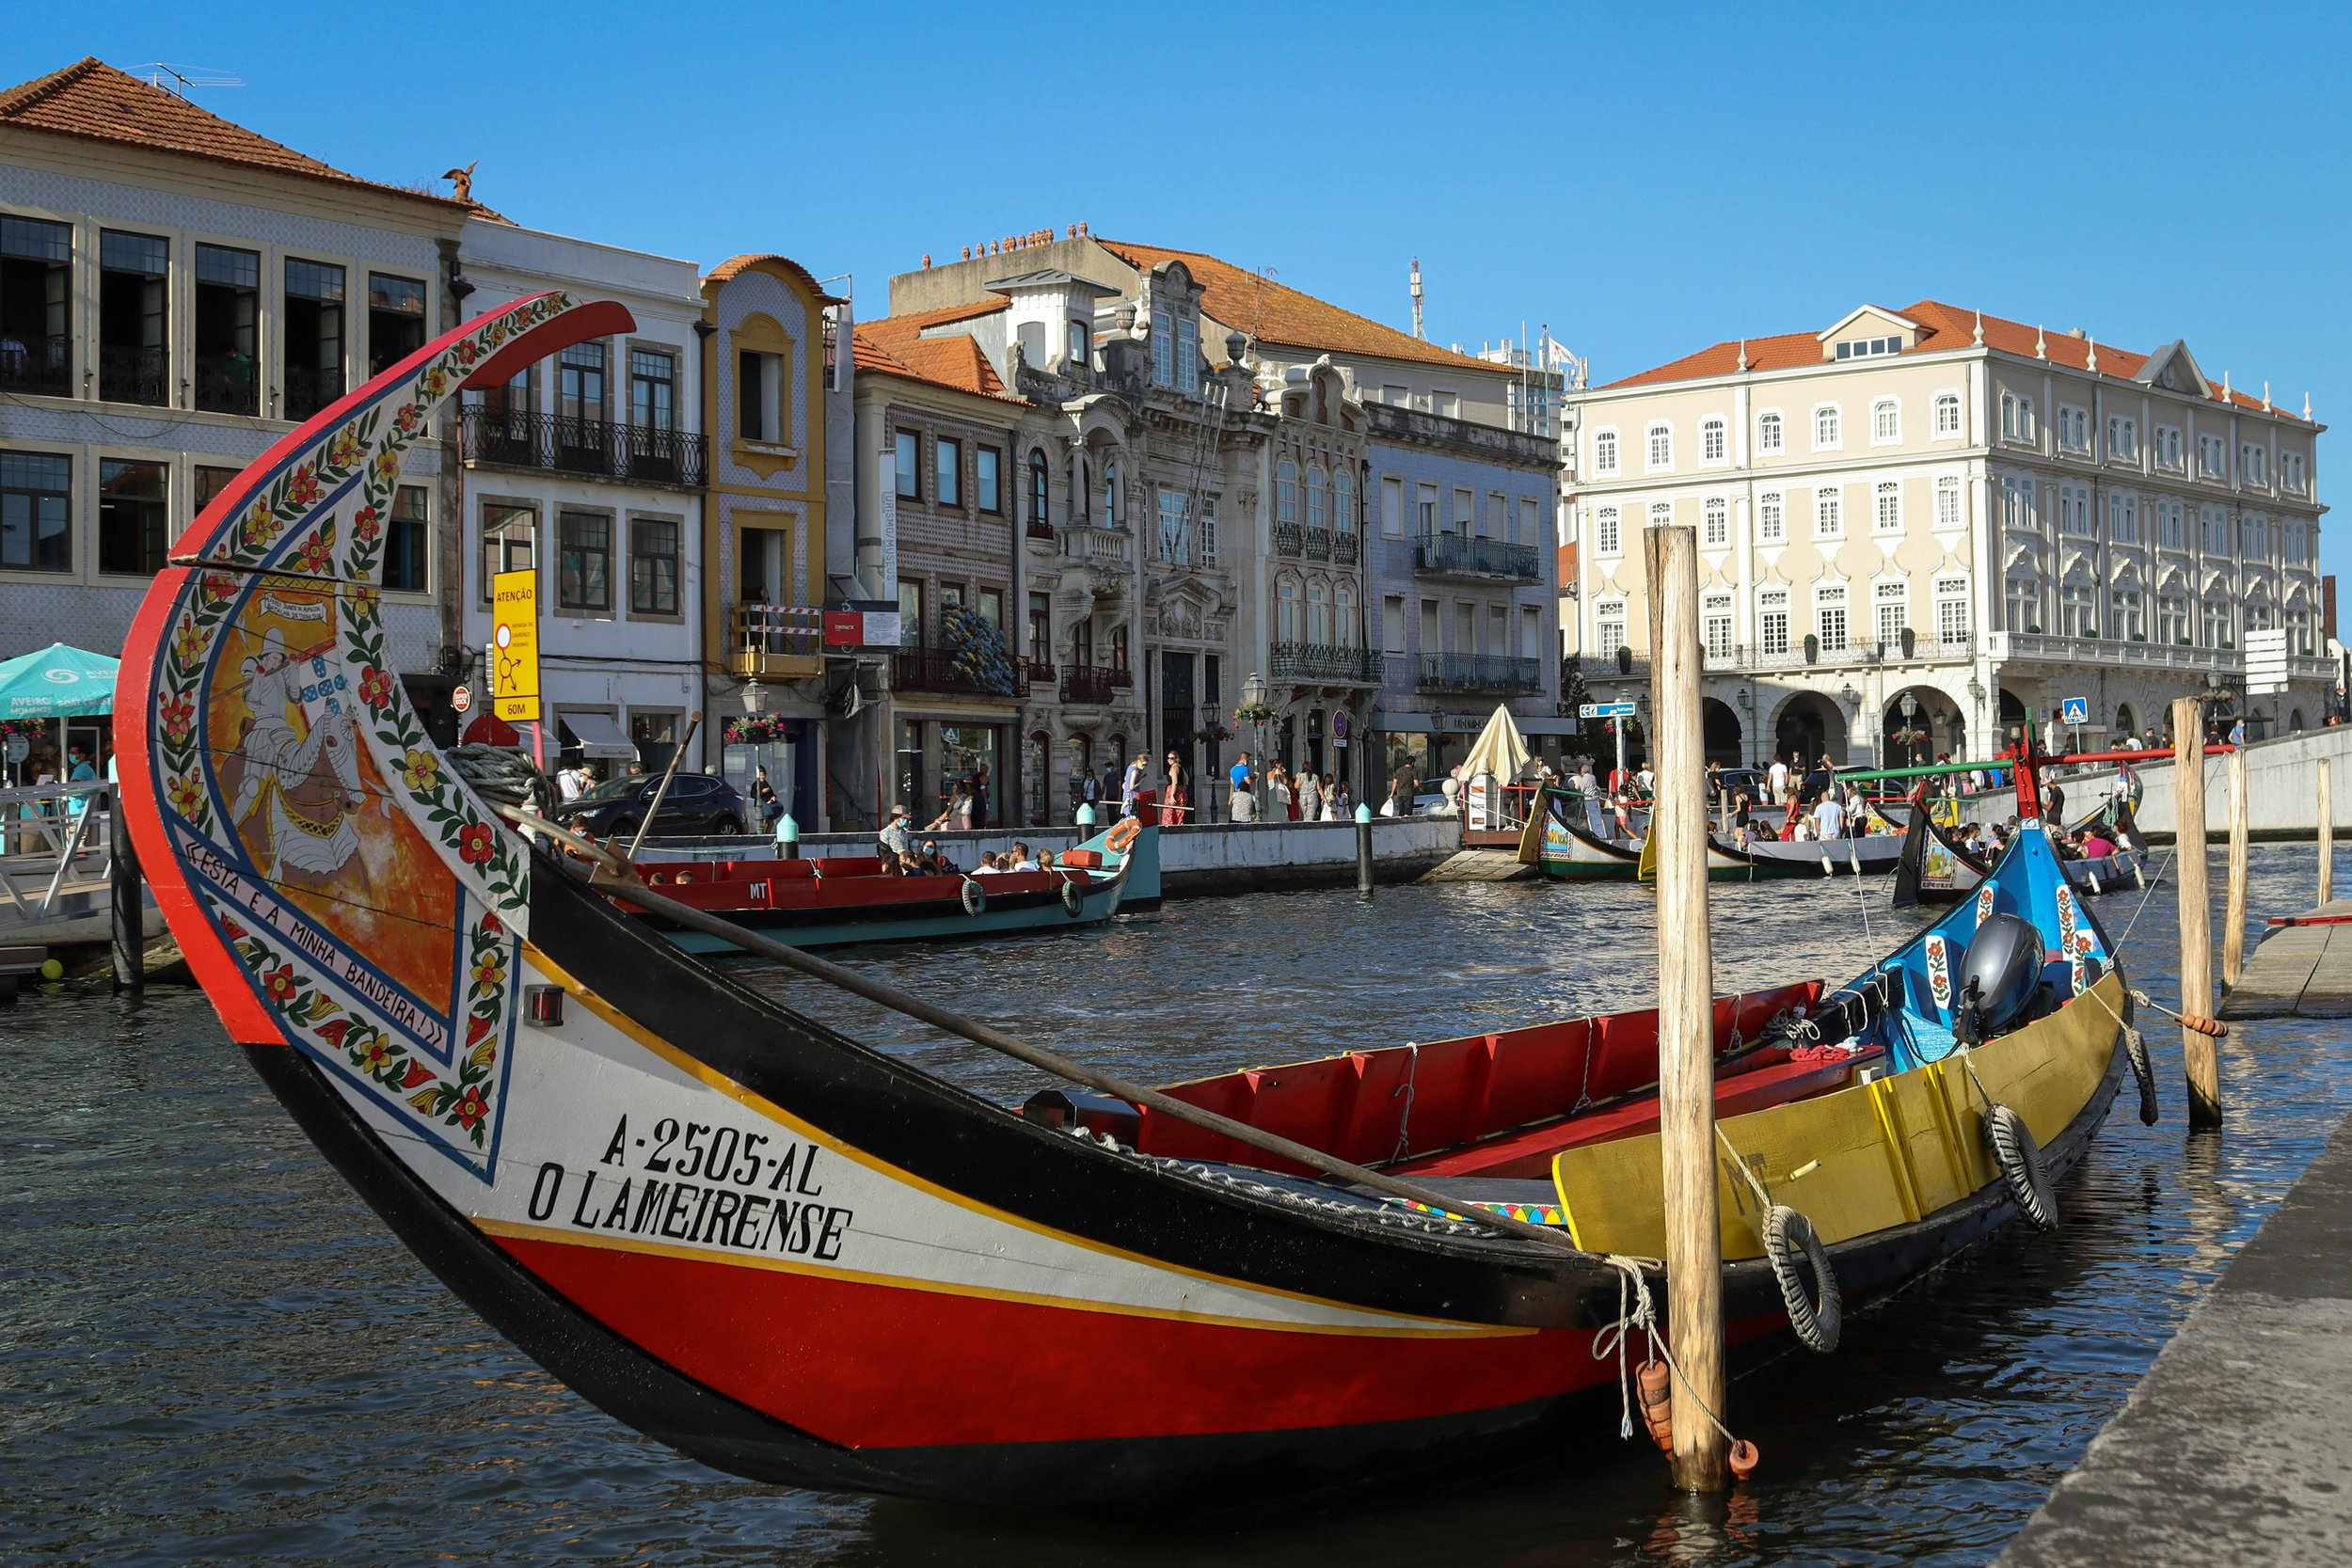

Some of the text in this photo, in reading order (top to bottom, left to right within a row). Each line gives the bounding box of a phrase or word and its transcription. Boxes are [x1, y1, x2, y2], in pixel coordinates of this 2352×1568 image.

[885, 489, 896, 581] TURISMO/MUSEUS
[497, 588, 532, 603] ATENÇÃO
[10, 696, 51, 707] AVEIRO
[507, 704, 526, 715] 60M
[750, 882, 767, 899] MT
[265, 906, 279, 926] A
[290, 921, 337, 967] MINHA
[1721, 1153, 1772, 1215] MT
[527, 1162, 853, 1260] O LAMEIRENSE
